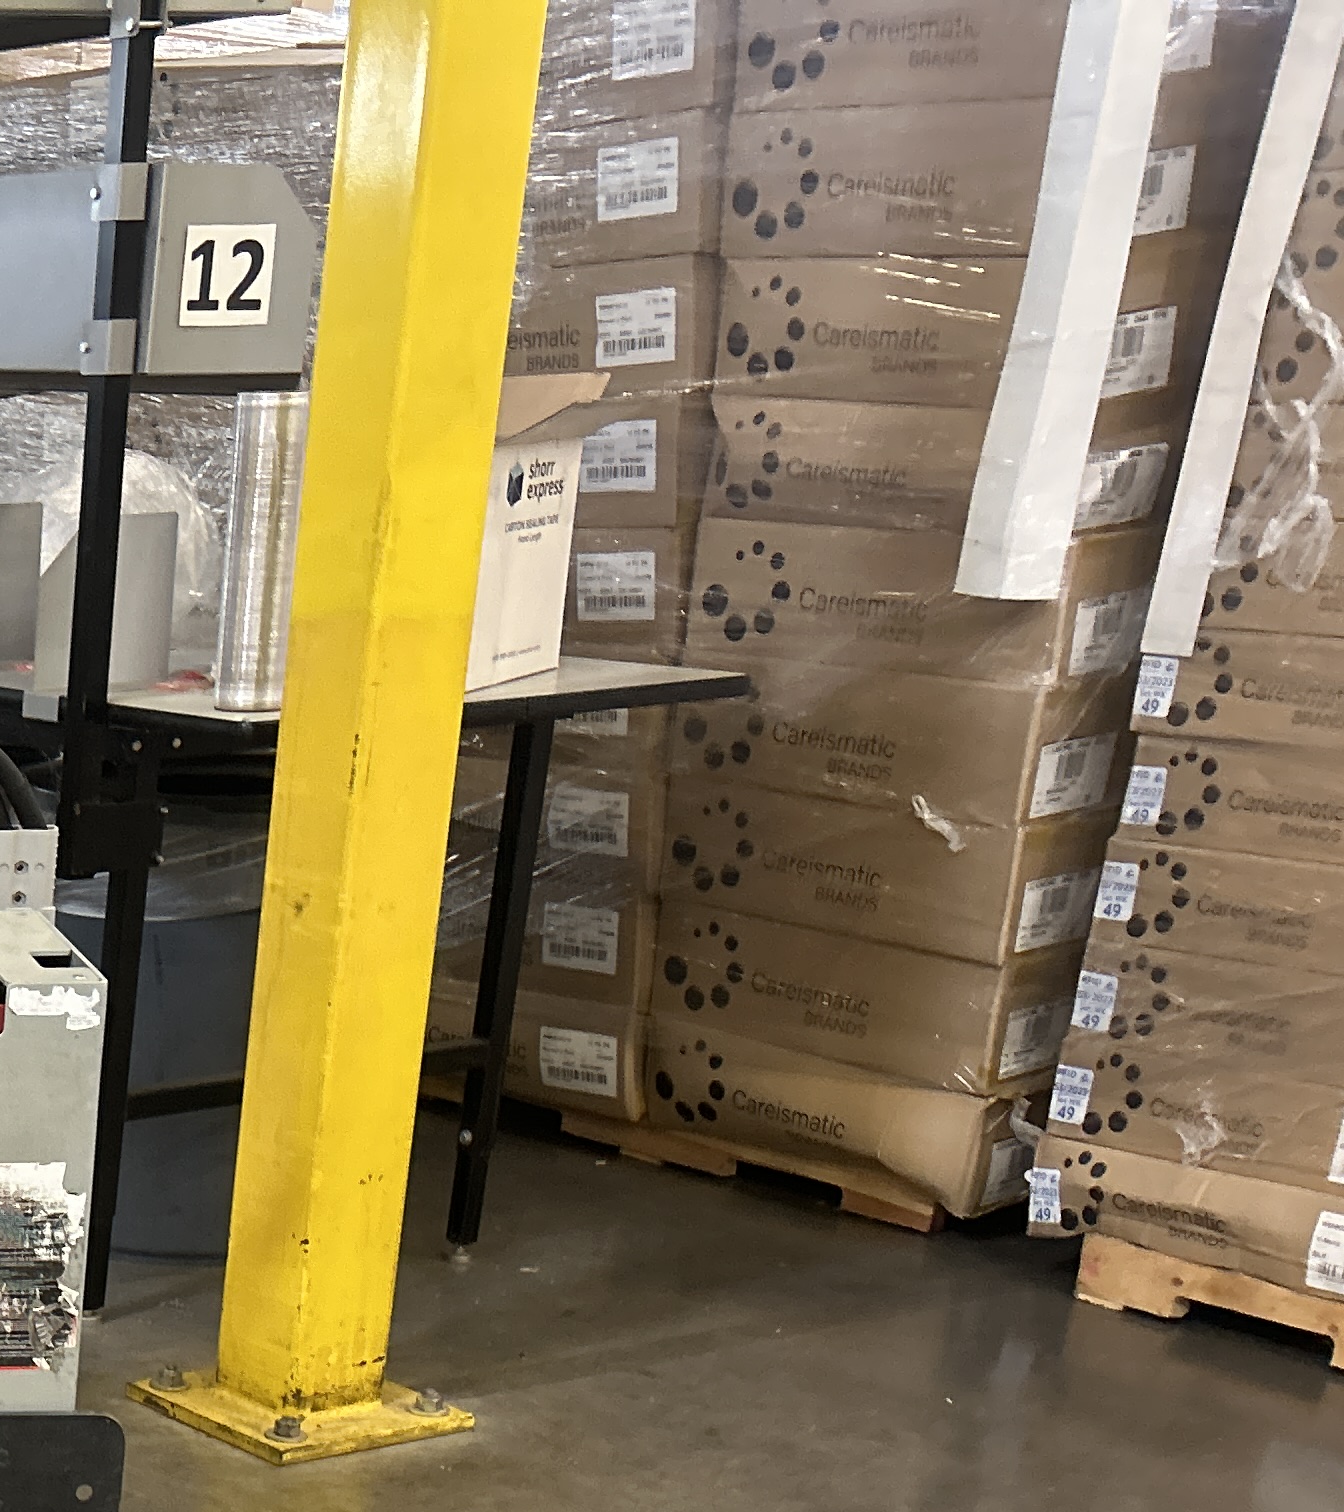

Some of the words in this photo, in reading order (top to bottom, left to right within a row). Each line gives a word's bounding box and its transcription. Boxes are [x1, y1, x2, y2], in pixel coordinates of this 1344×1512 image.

[828, 170, 957, 198] Careismatic
[187, 240, 265, 311] 12
[813, 322, 940, 352] Careismatic
[527, 352, 581, 372] BRANDS
[528, 458, 557, 480] shorr
[786, 457, 907, 490] Careismatic
[527, 478, 564, 503] express
[1141, 698, 1160, 714] 49
[772, 721, 896, 760] Careismatic
[827, 757, 893, 782] BRANDS
[1130, 808, 1149, 823] 49
[762, 850, 883, 889] Careismatic
[814, 885, 880, 913] BRANDS
[1103, 903, 1122, 917] 49
[750, 971, 871, 1018] Careismatic
[803, 1010, 869, 1040] BRANDS
[1081, 1013, 1100, 1027] 49
[731, 1088, 847, 1141] Careismatic
[1057, 1105, 1076, 1119] 49
[1035, 1208, 1051, 1221] 49
[1112, 1192, 1227, 1234] Careismatic
